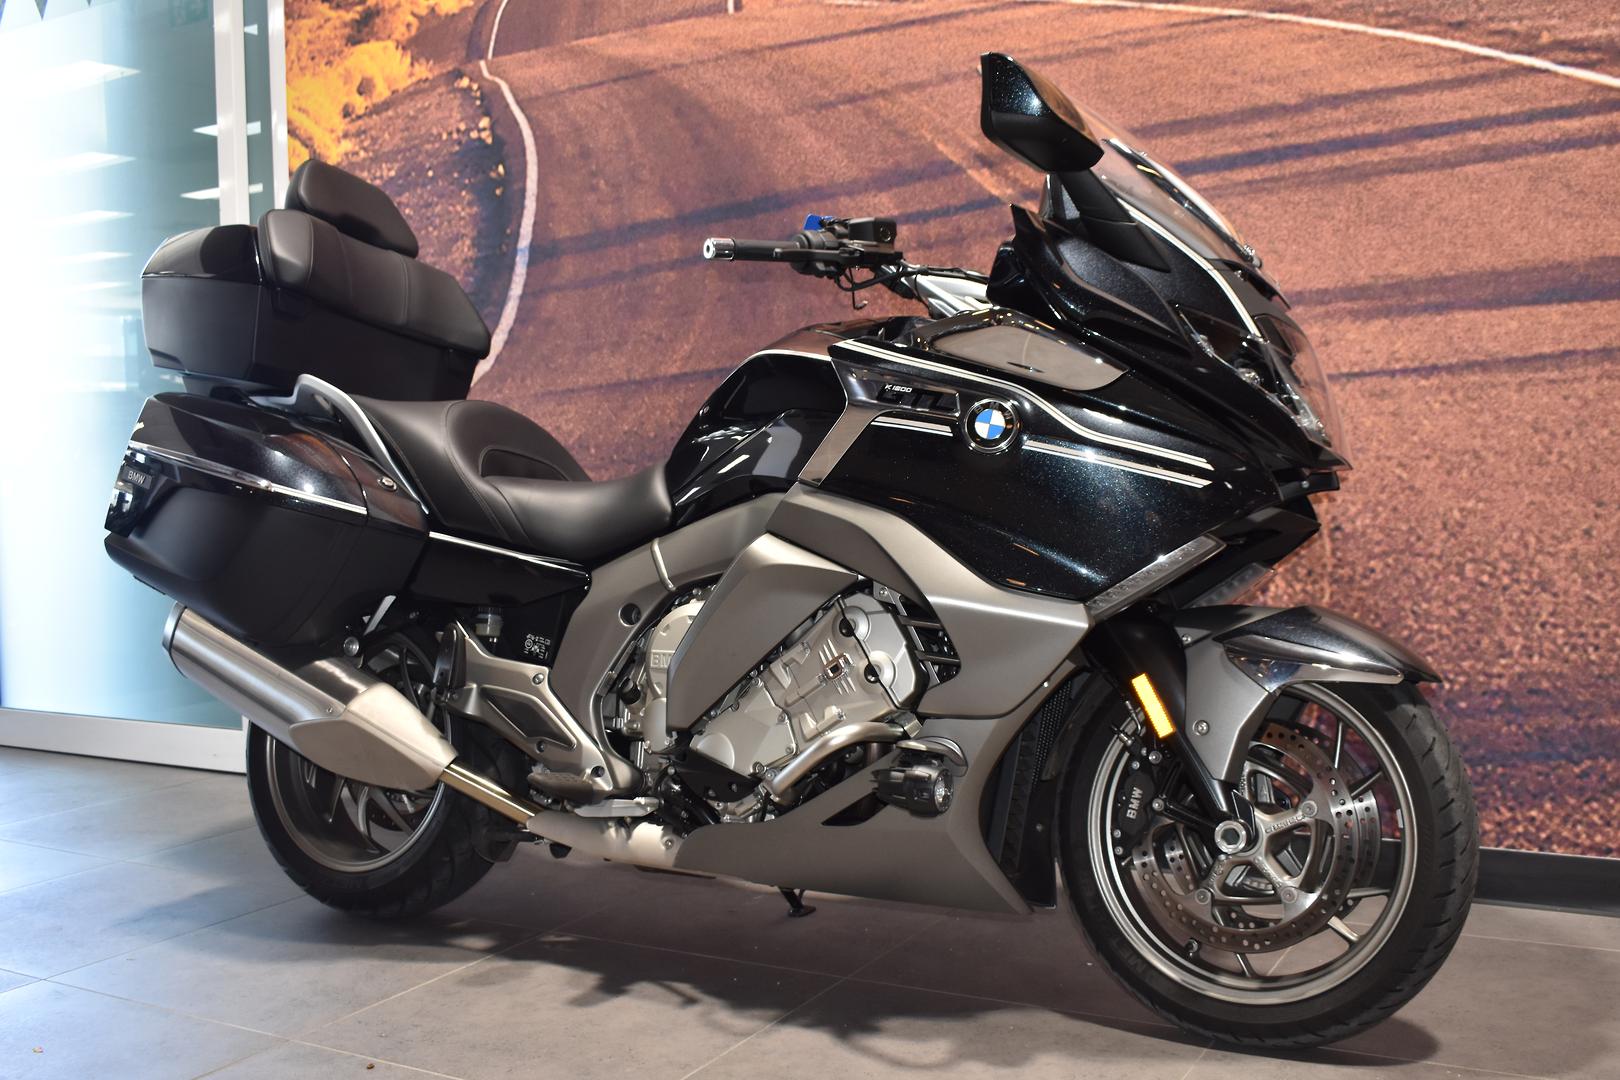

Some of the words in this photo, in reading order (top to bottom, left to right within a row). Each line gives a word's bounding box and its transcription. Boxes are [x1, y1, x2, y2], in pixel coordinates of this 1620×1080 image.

[127, 470, 146, 485] BMW
[652, 653, 673, 667] BM
[1126, 786, 1143, 819] BMW
